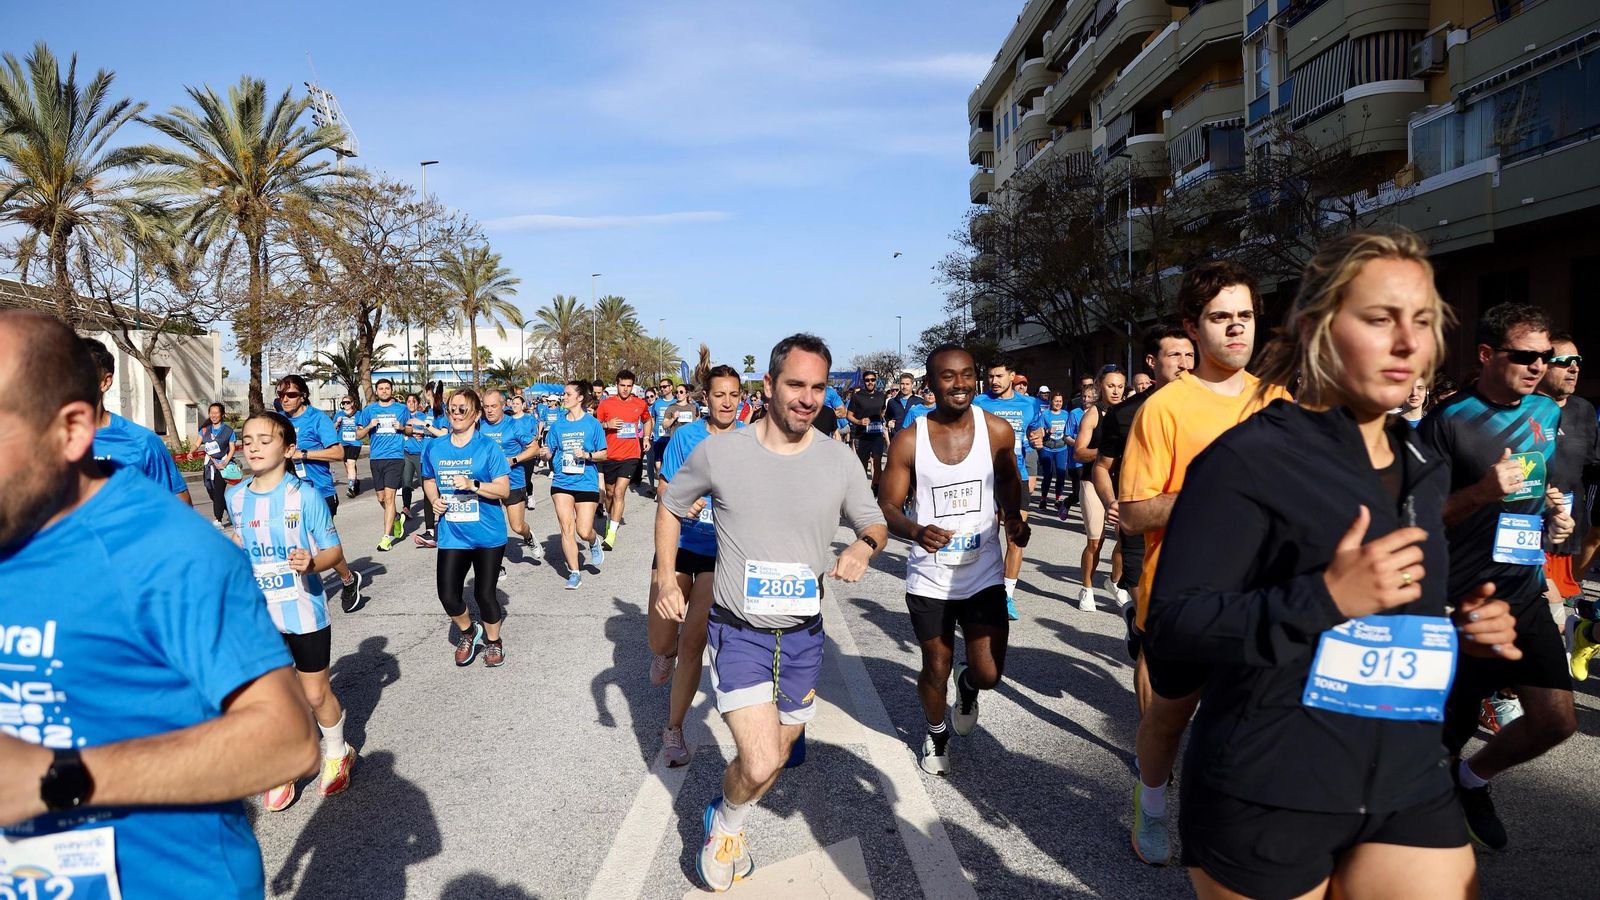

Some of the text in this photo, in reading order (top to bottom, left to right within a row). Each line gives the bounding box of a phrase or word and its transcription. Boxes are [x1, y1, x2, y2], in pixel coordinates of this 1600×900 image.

[438, 458, 472, 467] mayoral
[449, 503, 470, 512] 2835
[759, 579, 806, 596] 2805
[1359, 649, 1418, 680] 913
[1313, 677, 1349, 693] 10KM
